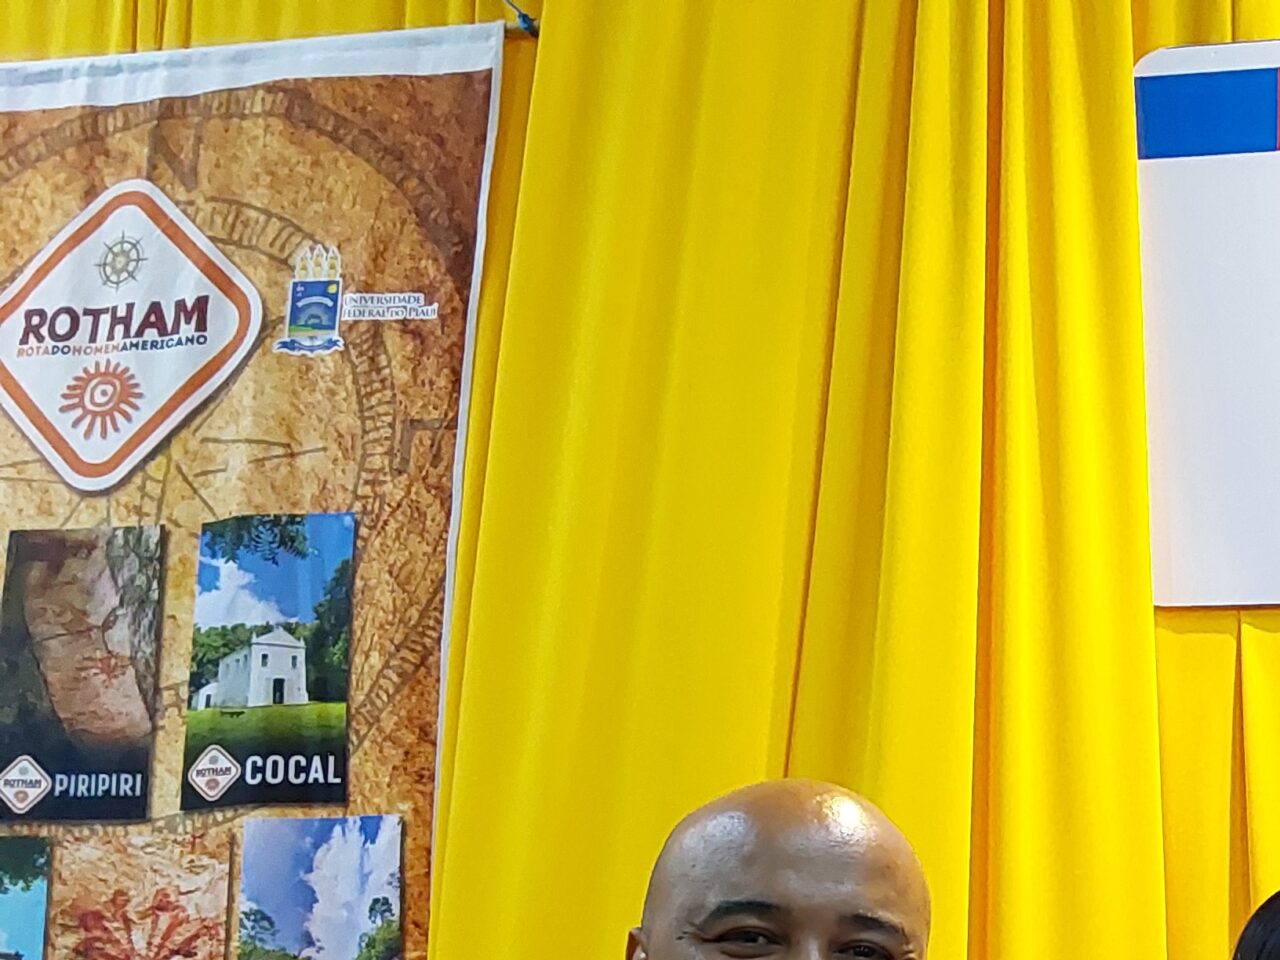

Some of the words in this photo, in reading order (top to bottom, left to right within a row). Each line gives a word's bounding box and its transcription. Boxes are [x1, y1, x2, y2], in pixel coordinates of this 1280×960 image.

[344, 294, 424, 305] UNIVERSIDADE
[18, 294, 210, 347] ROTHAM
[245, 754, 342, 785] COCAL
[54, 773, 142, 797] PIRIPIRI
